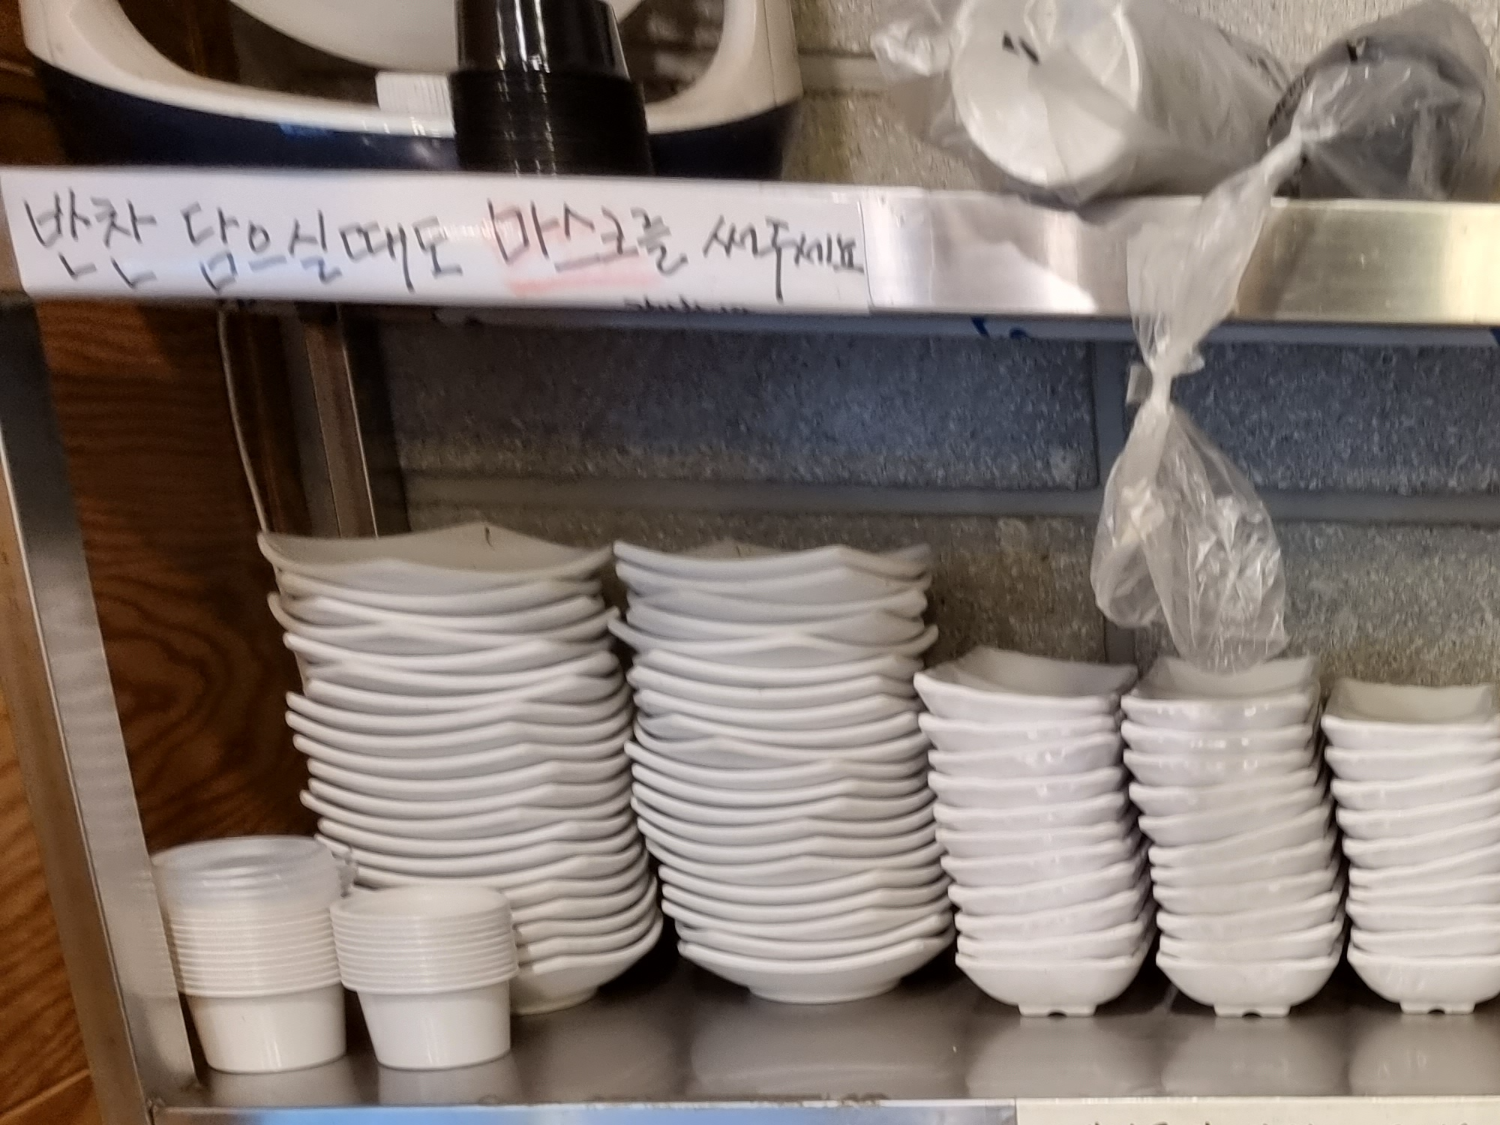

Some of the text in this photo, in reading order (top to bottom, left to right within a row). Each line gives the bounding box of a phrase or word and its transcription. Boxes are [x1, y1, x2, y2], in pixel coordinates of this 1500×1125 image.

[23, 187, 157, 289] 반찬
[486, 198, 690, 277] 마스크를
[703, 214, 865, 304] 써주세요
